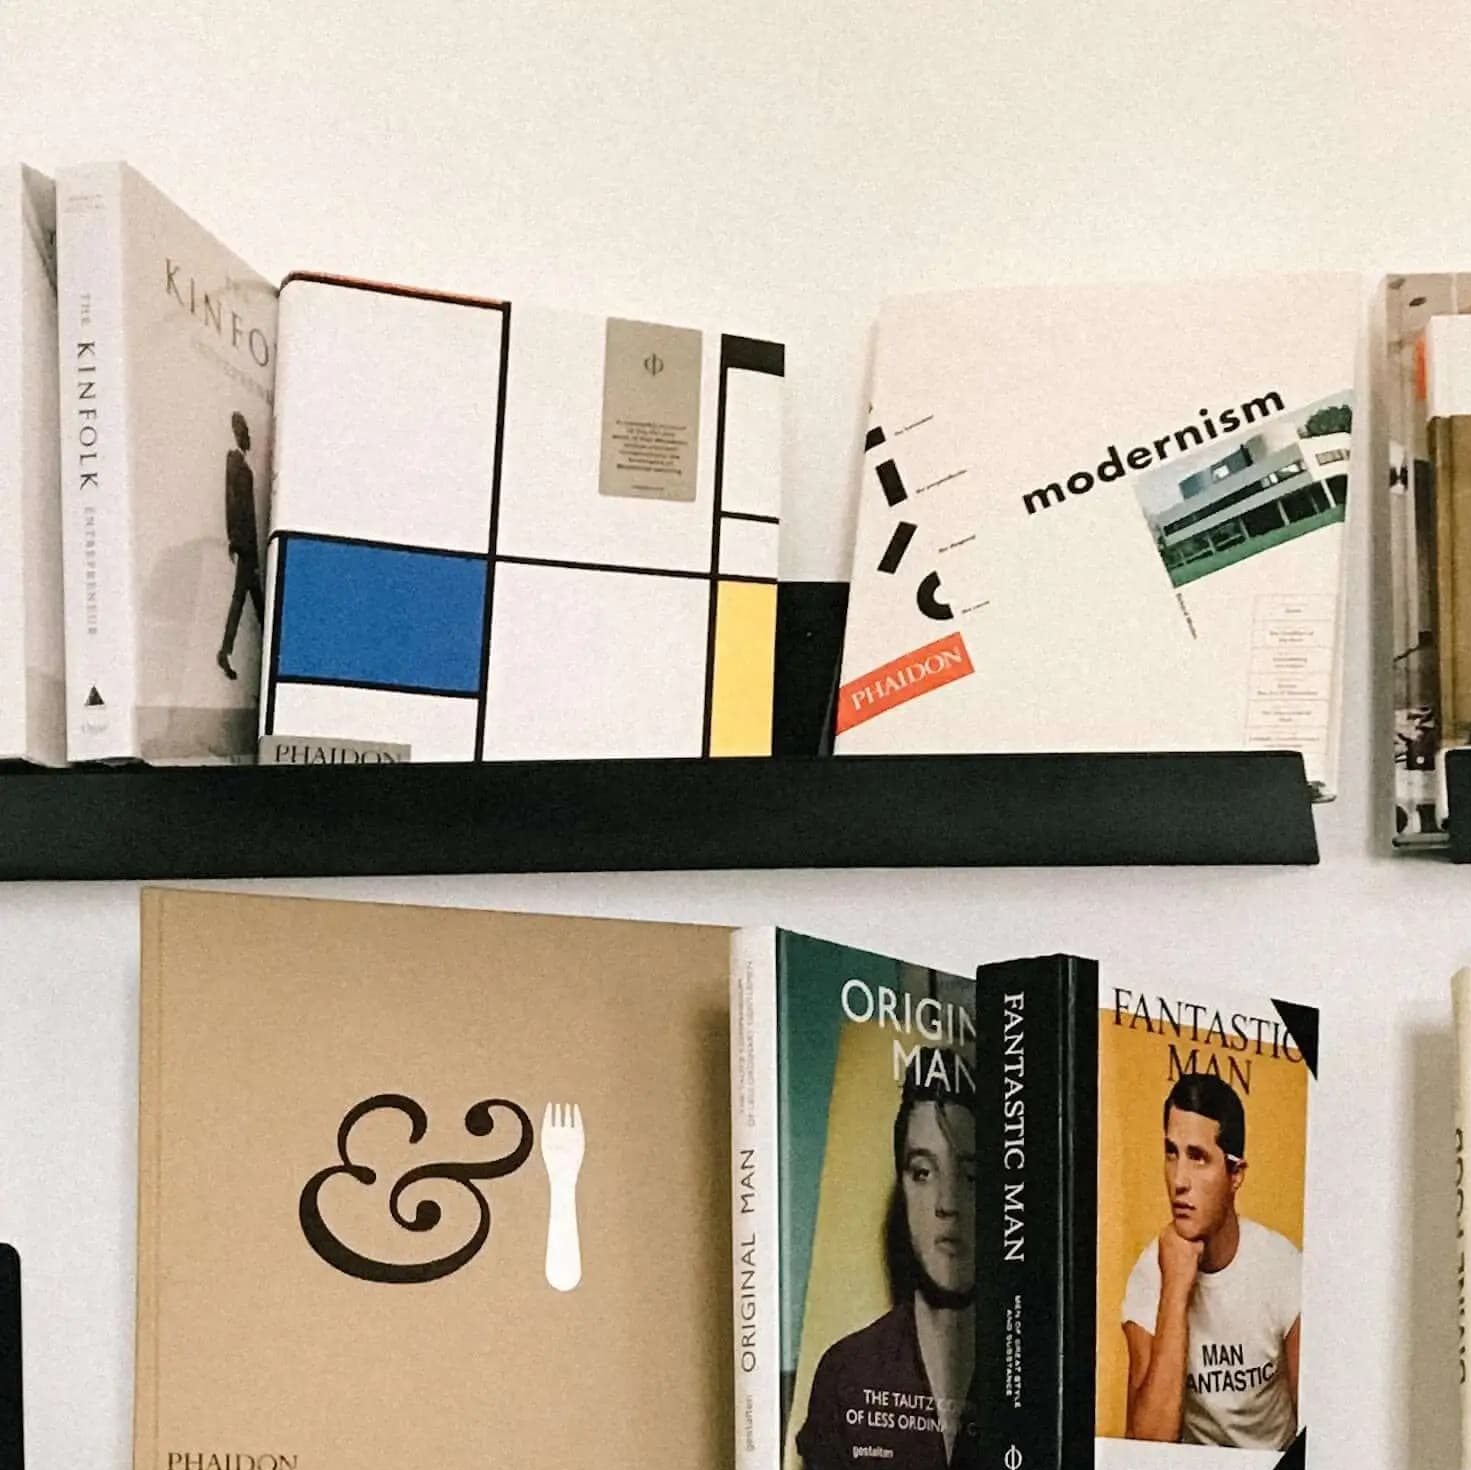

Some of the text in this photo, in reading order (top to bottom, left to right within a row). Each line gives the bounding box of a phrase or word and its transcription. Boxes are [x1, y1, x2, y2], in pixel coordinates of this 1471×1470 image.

[76, 341, 99, 490] KINFOLK
[1022, 390, 1285, 516] modernism
[850, 647, 963, 712] PHAIDON
[1113, 986, 1309, 1064] FANTASTIC
[1166, 1043, 1252, 1097] MAN
[1003, 992, 1026, 1263] FANTASTIC MAN
[298, 1092, 534, 1285] &
[740, 1148, 757, 1373] ORIGINAL MAN
[1186, 1361, 1275, 1393] ANTASTIC
[1202, 1344, 1244, 1366] MAN
[845, 1408, 865, 1426] OF
[867, 1411, 895, 1429] LESS
[863, 1388, 890, 1407] THE
[892, 1392, 935, 1412] TAUTZ
